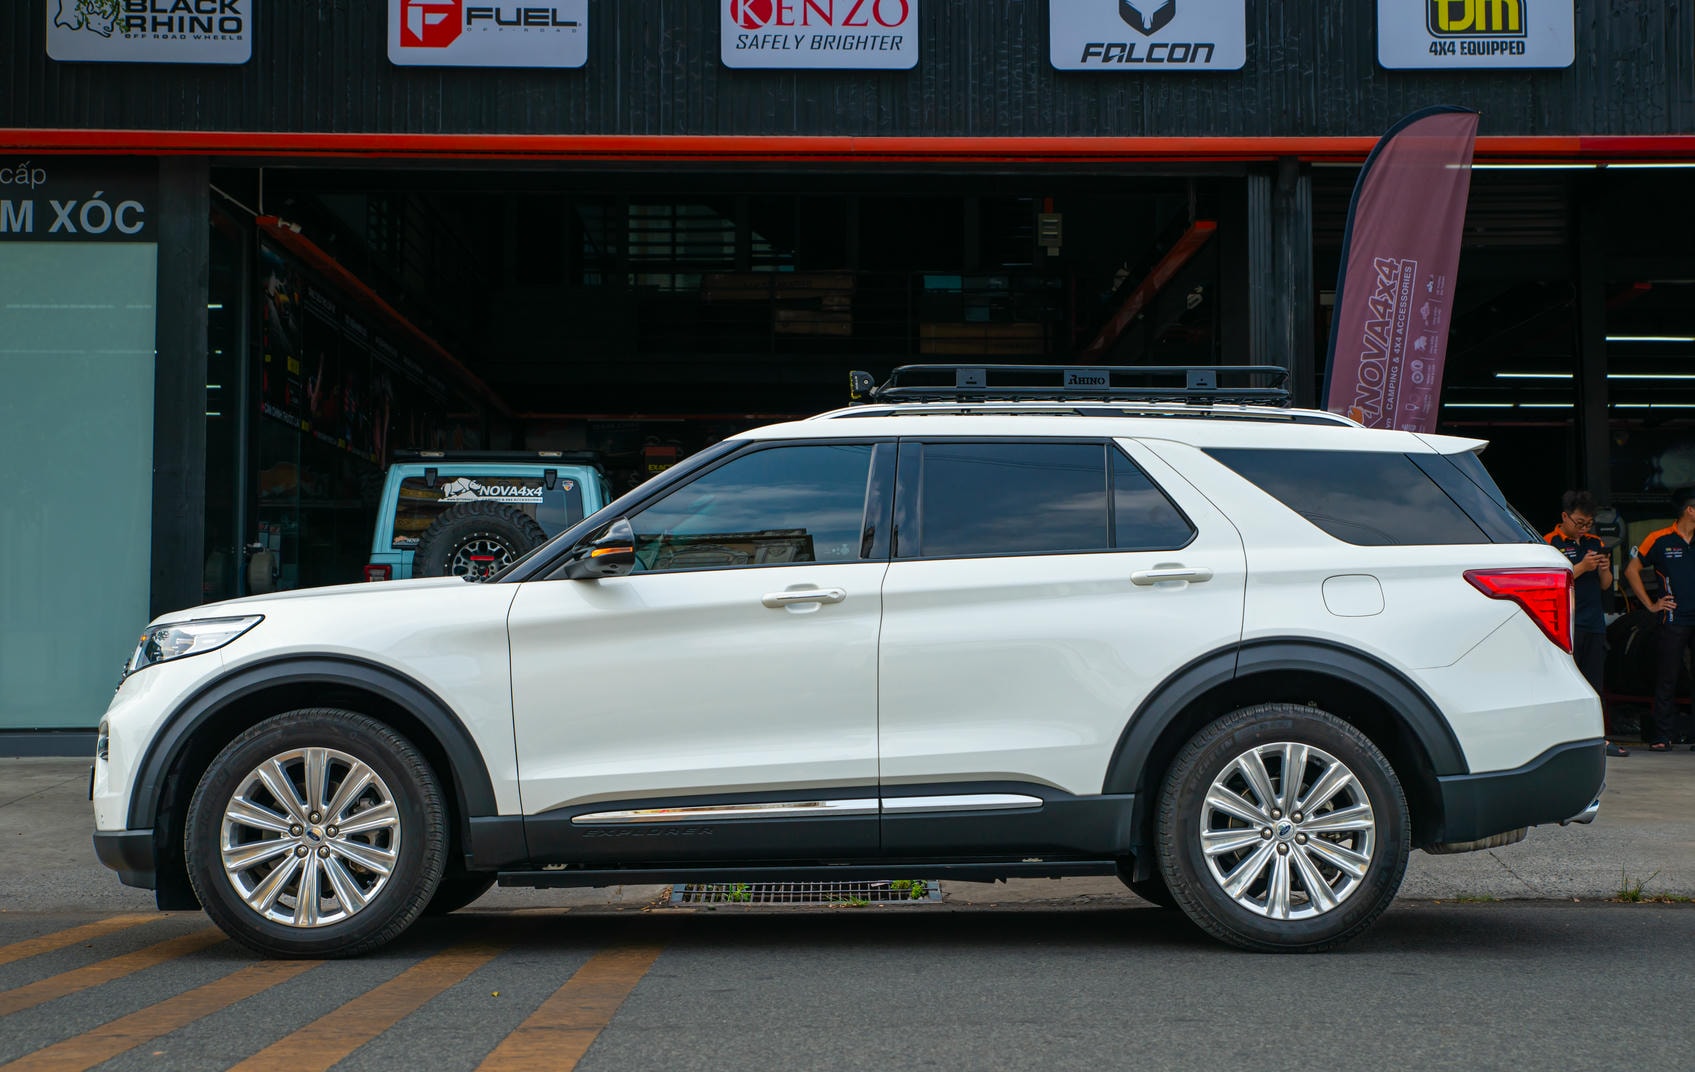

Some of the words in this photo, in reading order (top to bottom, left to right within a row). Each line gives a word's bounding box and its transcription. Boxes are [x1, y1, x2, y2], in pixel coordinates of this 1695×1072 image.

[124, 0, 242, 14] BLACK
[730, 0, 909, 29] KENZO
[125, 15, 243, 34] RHINO
[466, 7, 578, 27] FUEL
[735, 34, 806, 50] SAFELY
[810, 34, 903, 51] BRIGHTER
[1428, 41, 1456, 56] 4X4
[1460, 41, 1526, 56] EQUIPPED
[1080, 42, 1216, 63] FALCON
[0, 160, 47, 190] cấp
[0, 199, 34, 233] M
[47, 190, 145, 235] XÓC
[1386, 366, 1398, 411] CAMPING
[1392, 356, 1400, 364] &
[1396, 265, 1413, 335] ACCESSORIES
[1068, 374, 1106, 385] RHINO
[480, 486, 544, 497] NOVA4x4
[582, 828, 713, 838] EXPLORER
